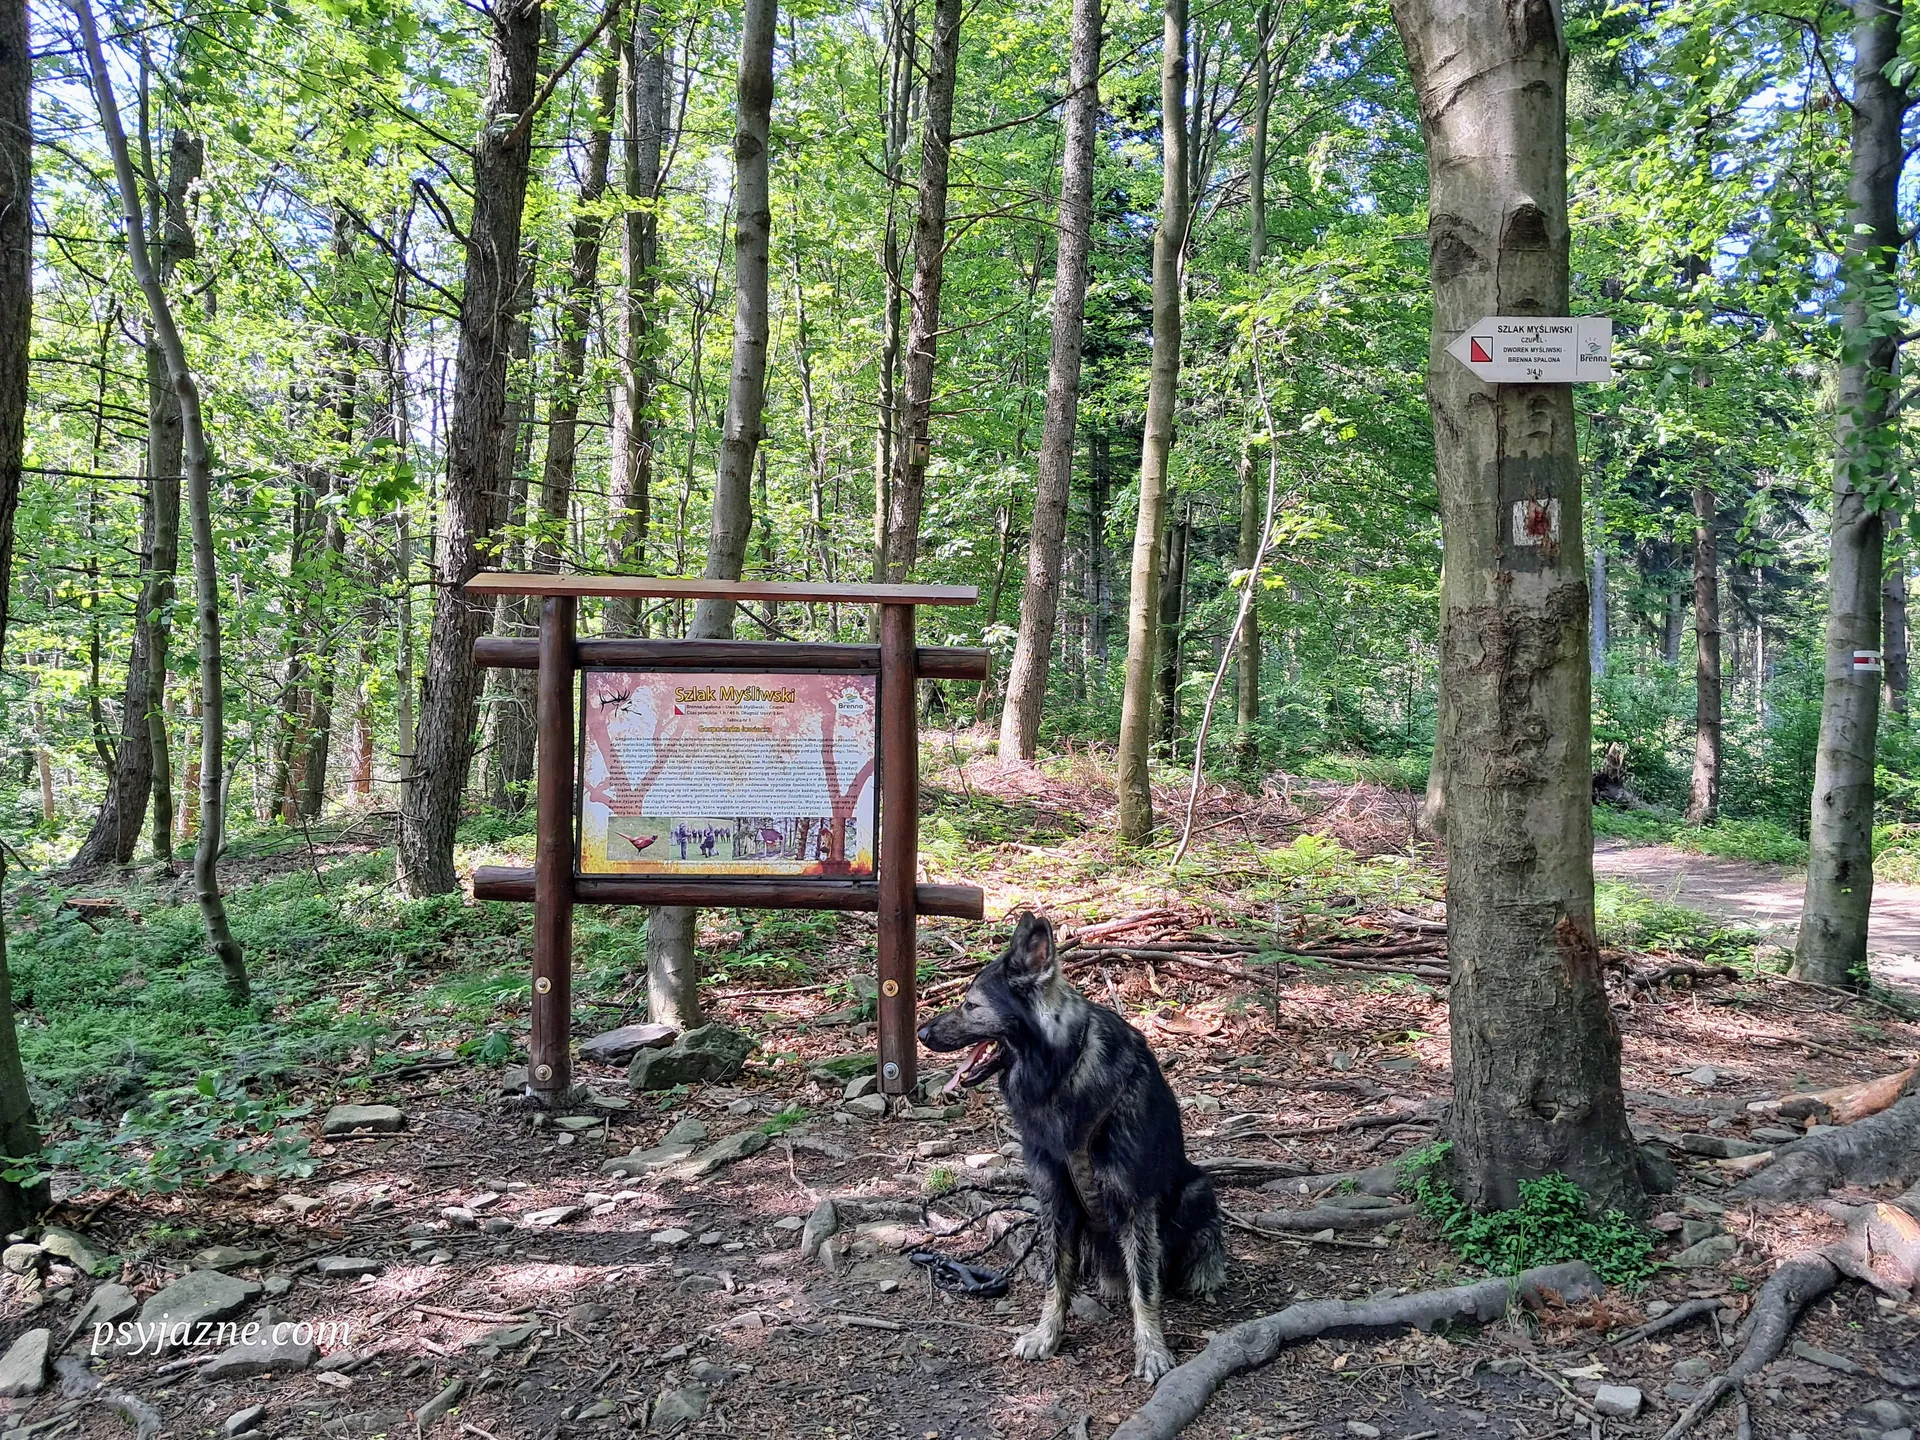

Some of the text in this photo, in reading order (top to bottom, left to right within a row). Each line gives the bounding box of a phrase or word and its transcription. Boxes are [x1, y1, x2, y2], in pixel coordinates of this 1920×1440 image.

[1497, 324, 1573, 334] SZLAK MYŚLIWSKI
[1580, 353, 1608, 362] Brenna
[674, 686, 796, 704] Szlak Myśliwski
